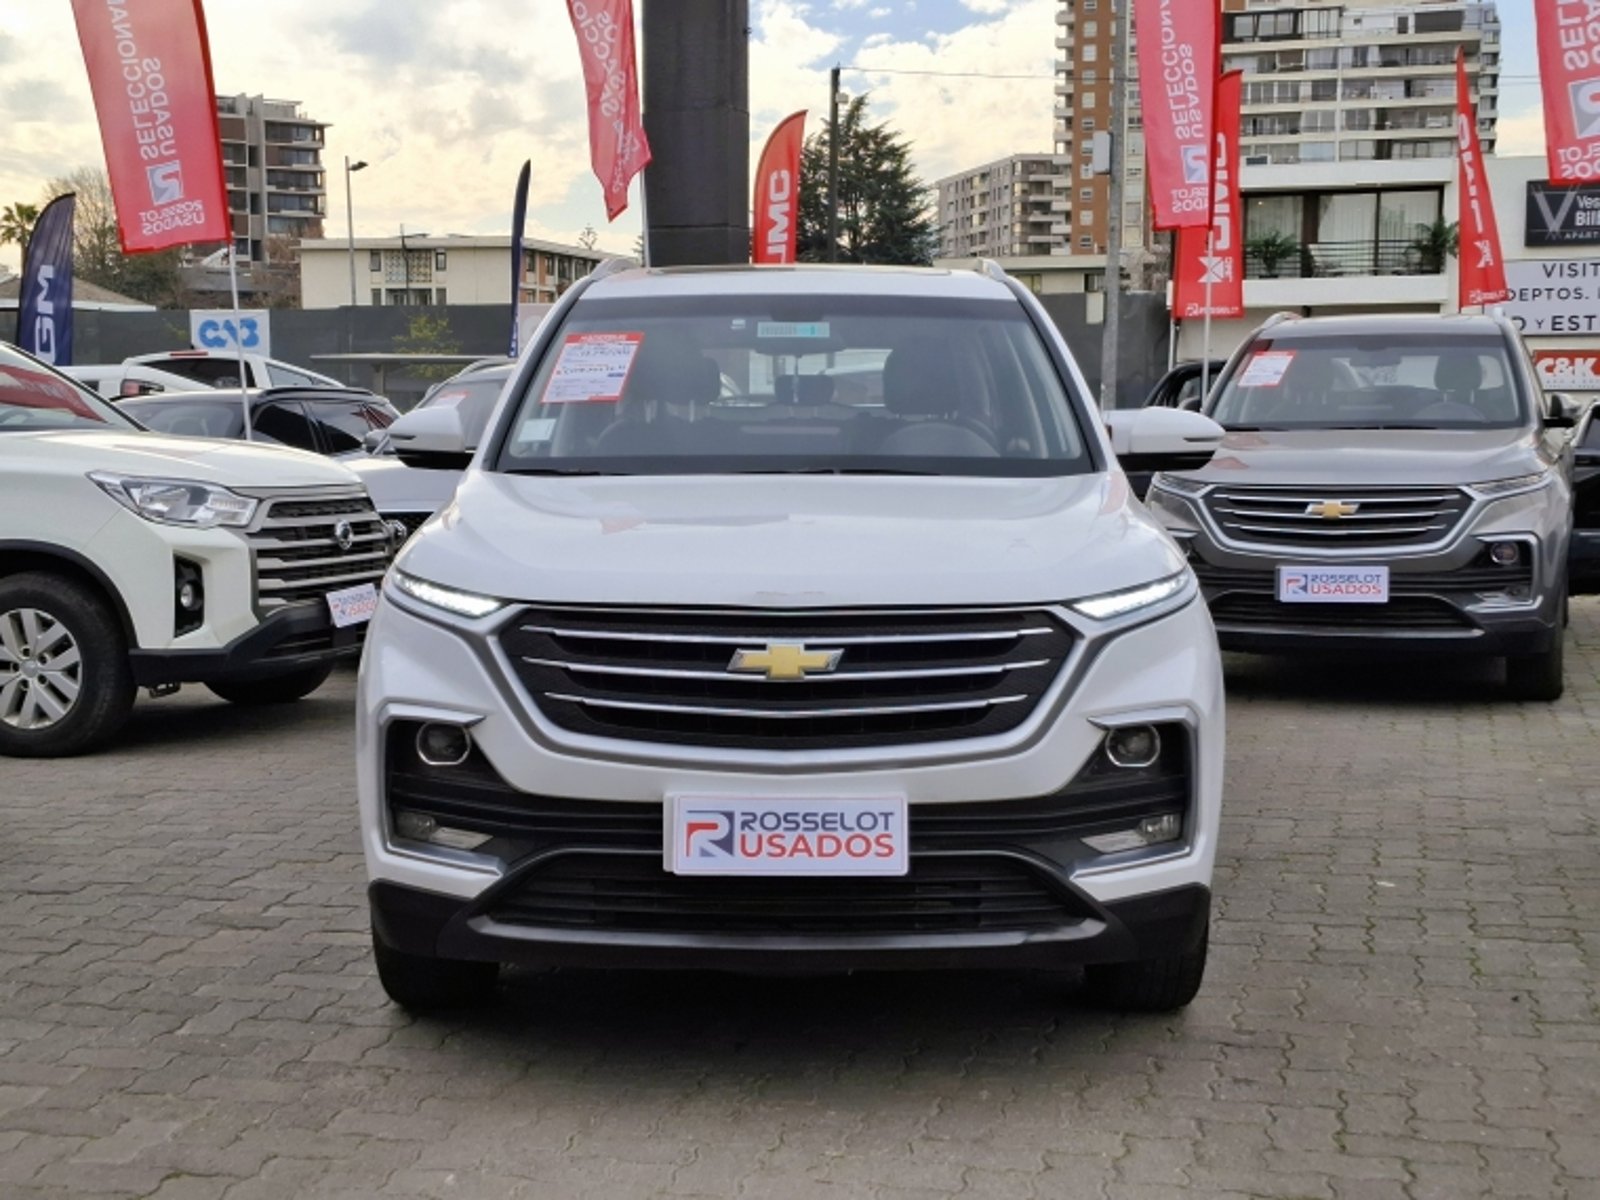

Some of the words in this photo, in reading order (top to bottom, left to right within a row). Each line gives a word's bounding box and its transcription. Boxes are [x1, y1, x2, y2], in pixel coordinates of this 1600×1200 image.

[1311, 584, 1382, 594] USADOS
[740, 812, 895, 832] ROSSELOT
[740, 834, 895, 859] USADOS
